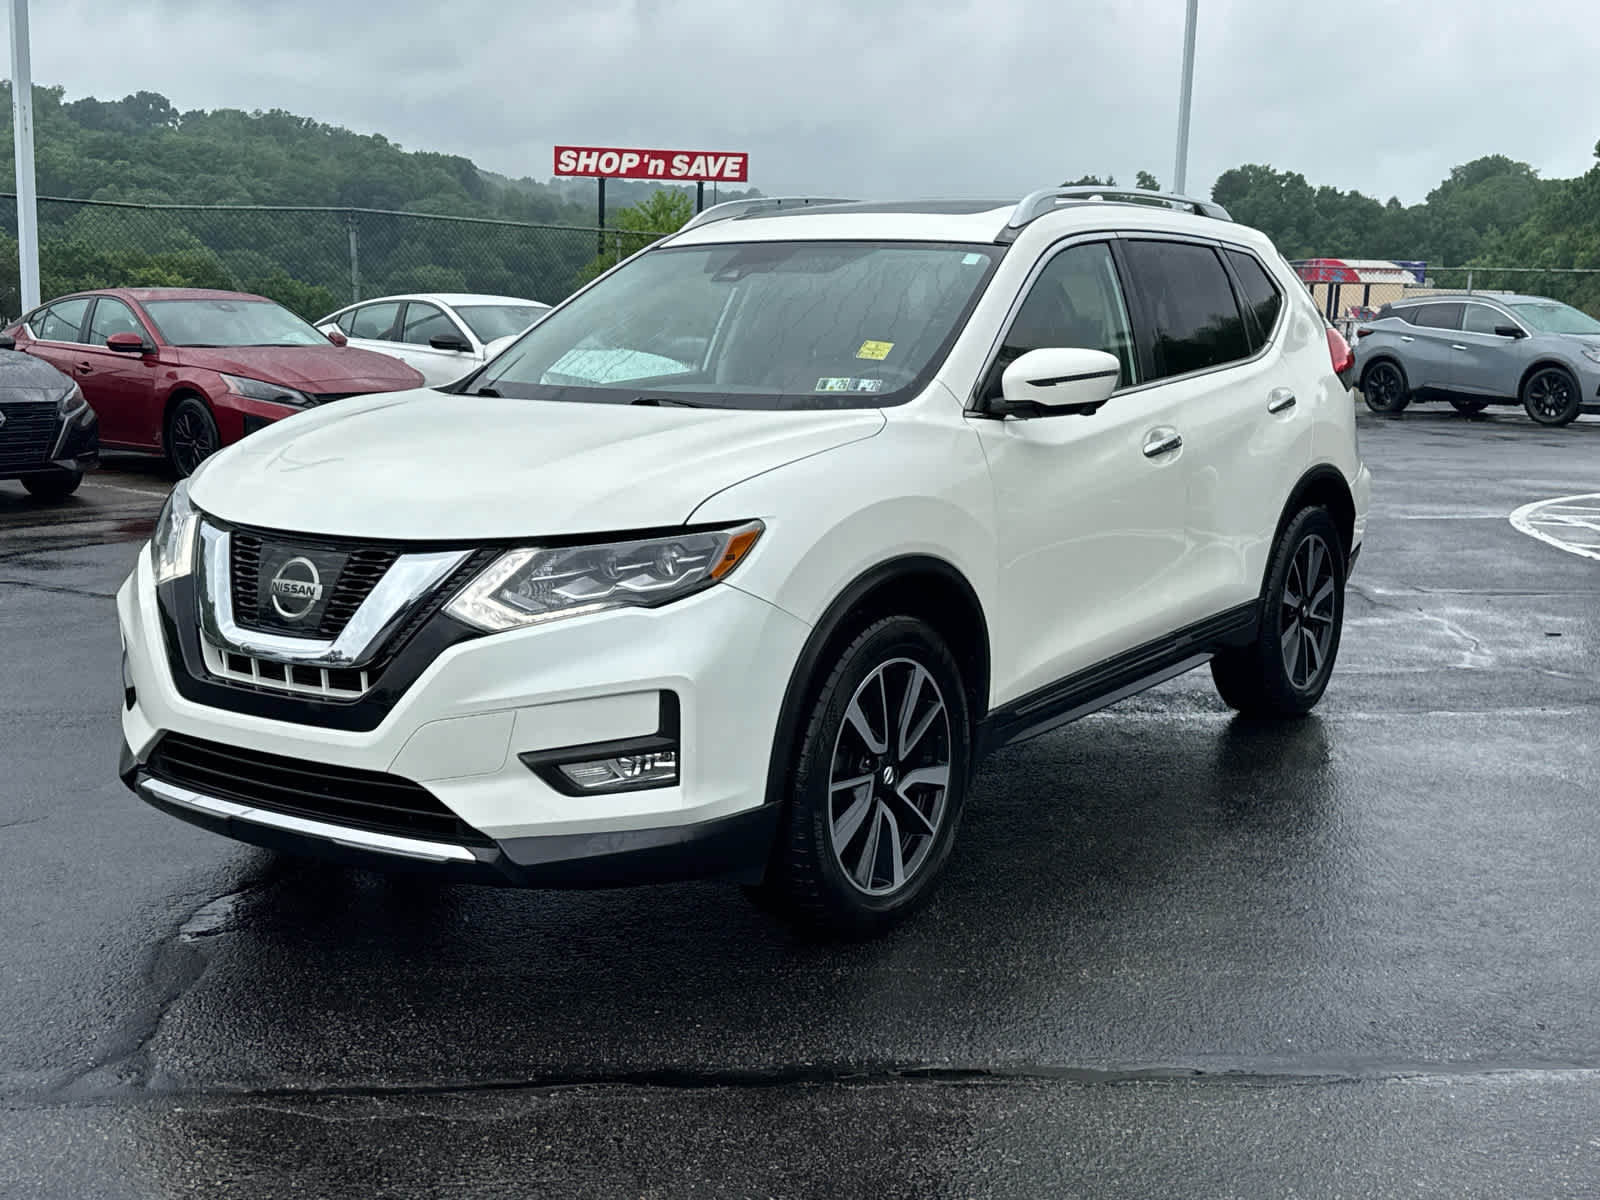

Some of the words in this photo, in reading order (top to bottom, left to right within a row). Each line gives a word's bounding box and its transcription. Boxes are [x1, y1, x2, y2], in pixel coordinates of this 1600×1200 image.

[558, 150, 640, 174] SHOP
[670, 155, 743, 178] SAVE
[272, 582, 315, 596] NISSAN
